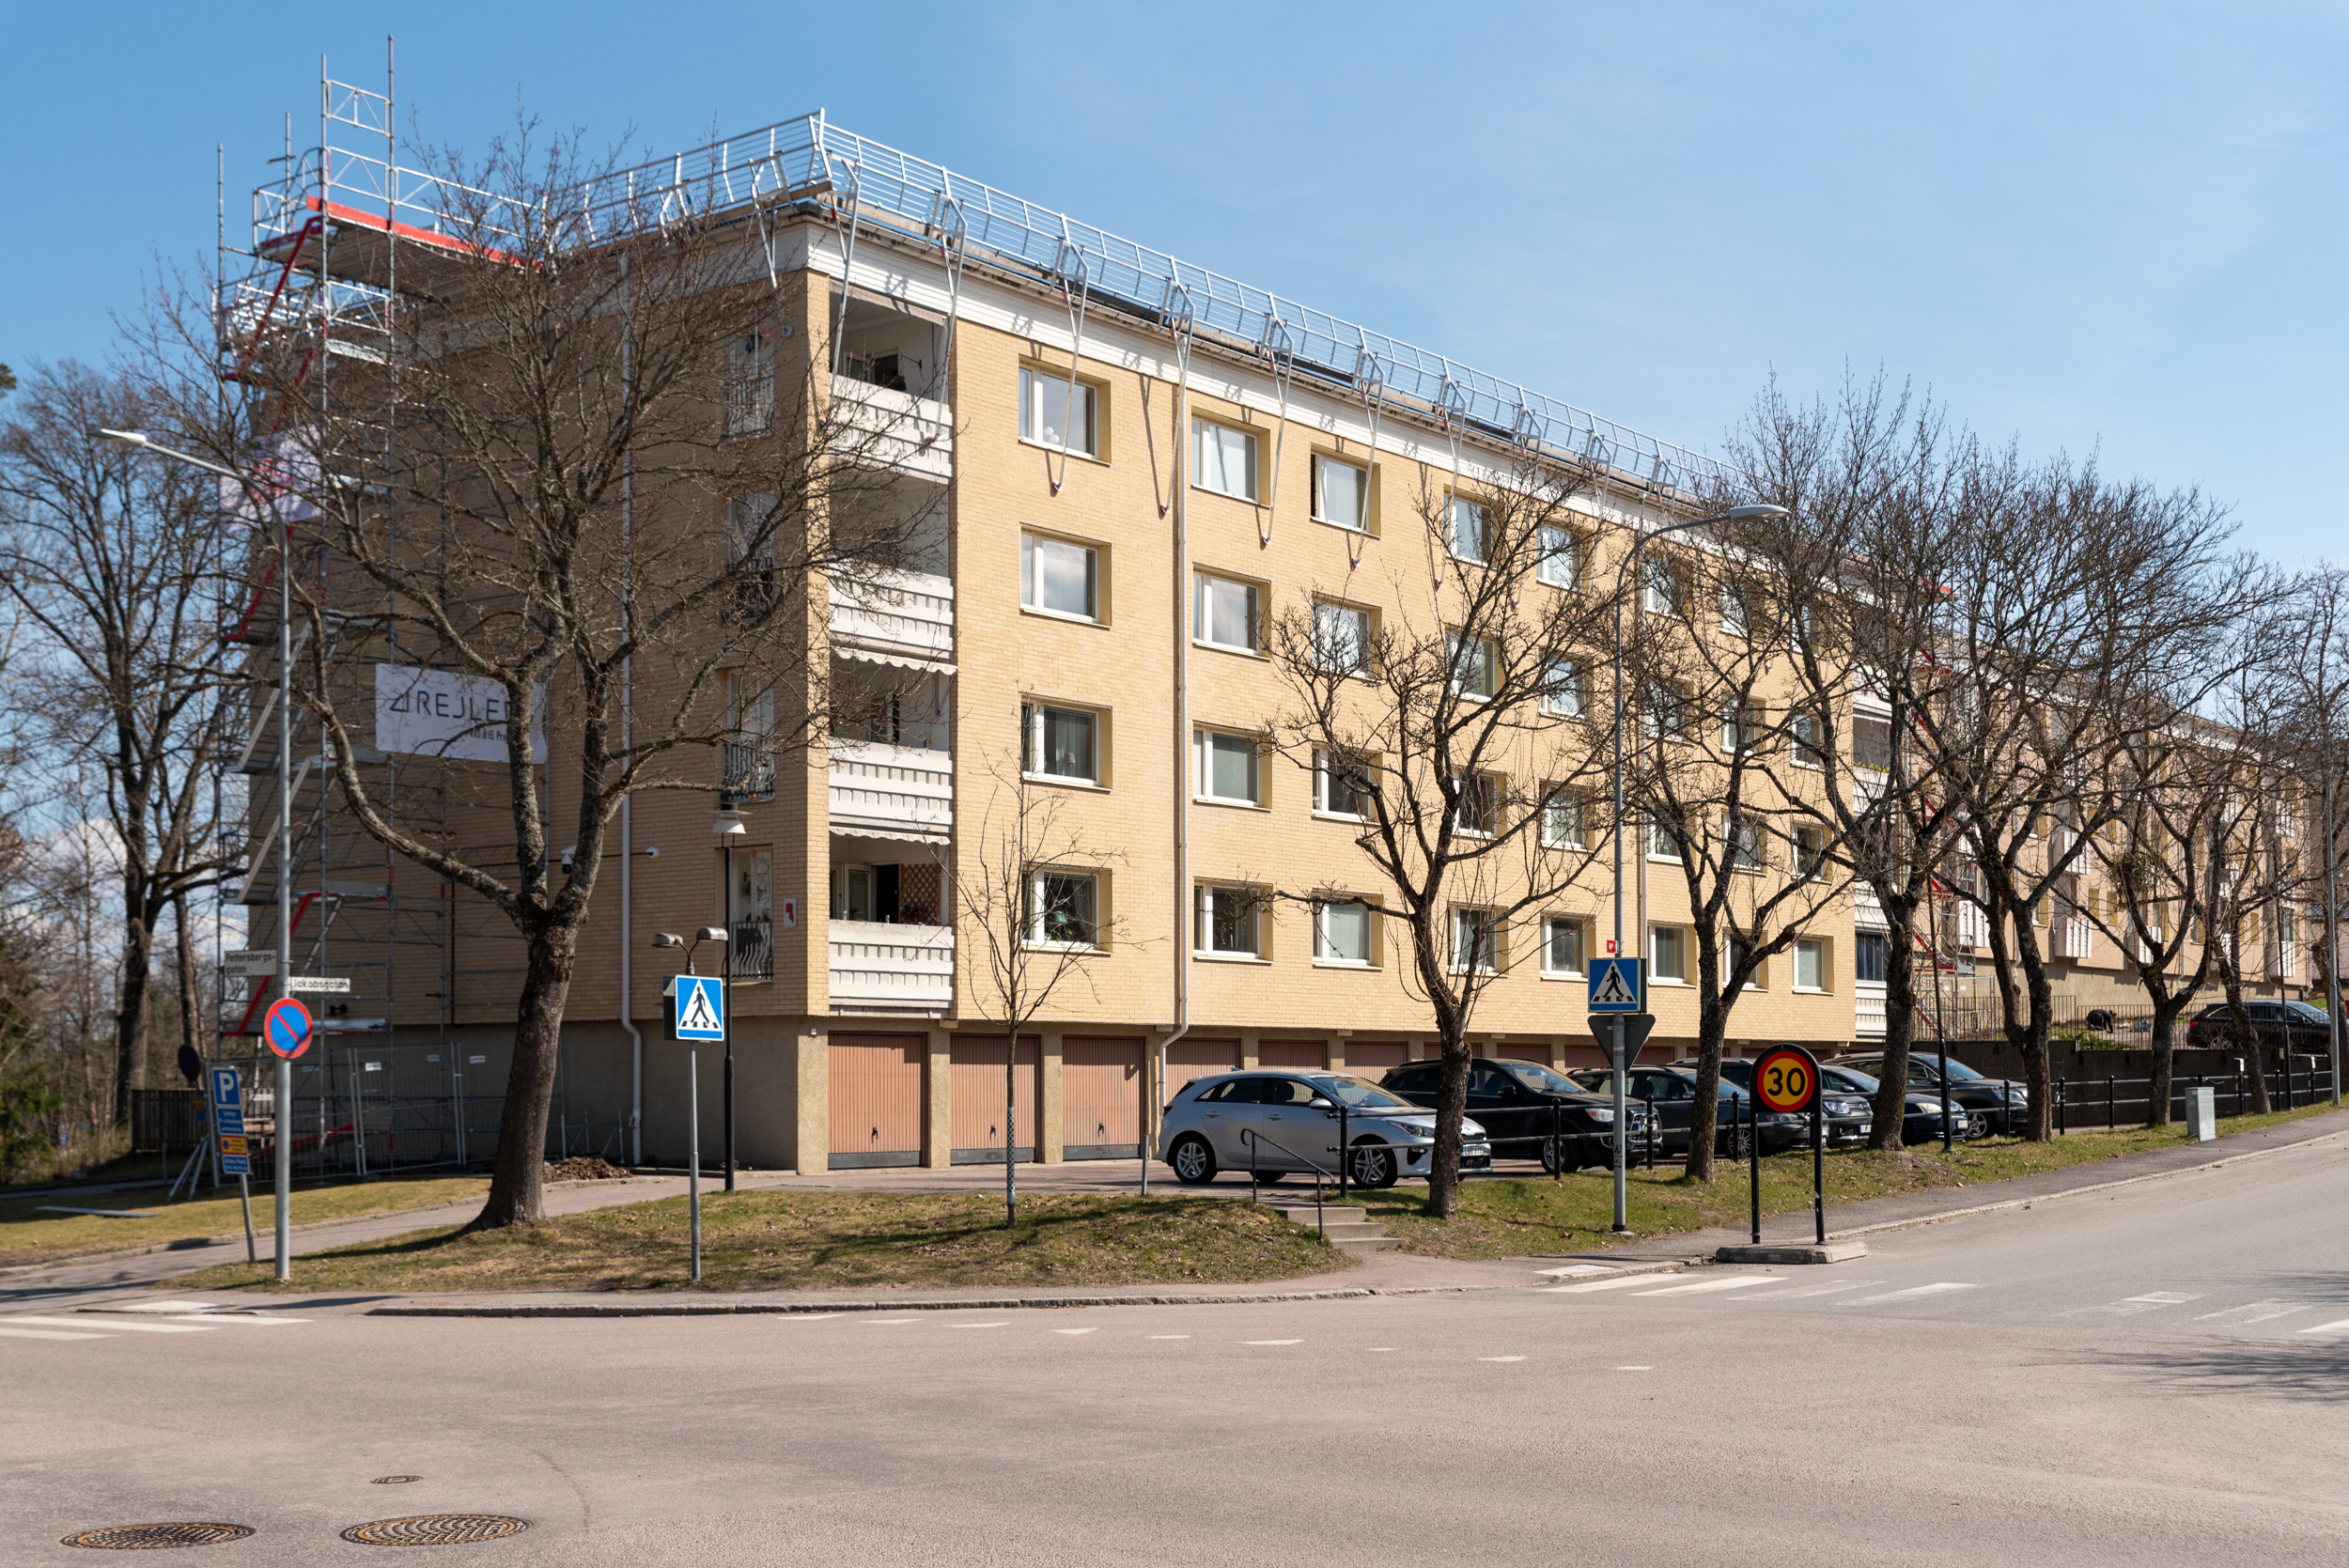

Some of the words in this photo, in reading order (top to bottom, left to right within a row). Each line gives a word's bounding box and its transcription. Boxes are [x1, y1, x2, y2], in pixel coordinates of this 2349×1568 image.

[417, 691, 534, 722] REJLE
[226, 965, 247, 975] gatan
[292, 979, 349, 990] Jakobsgatan
[218, 1072, 235, 1102] P
[1766, 1066, 1806, 1096] 30
